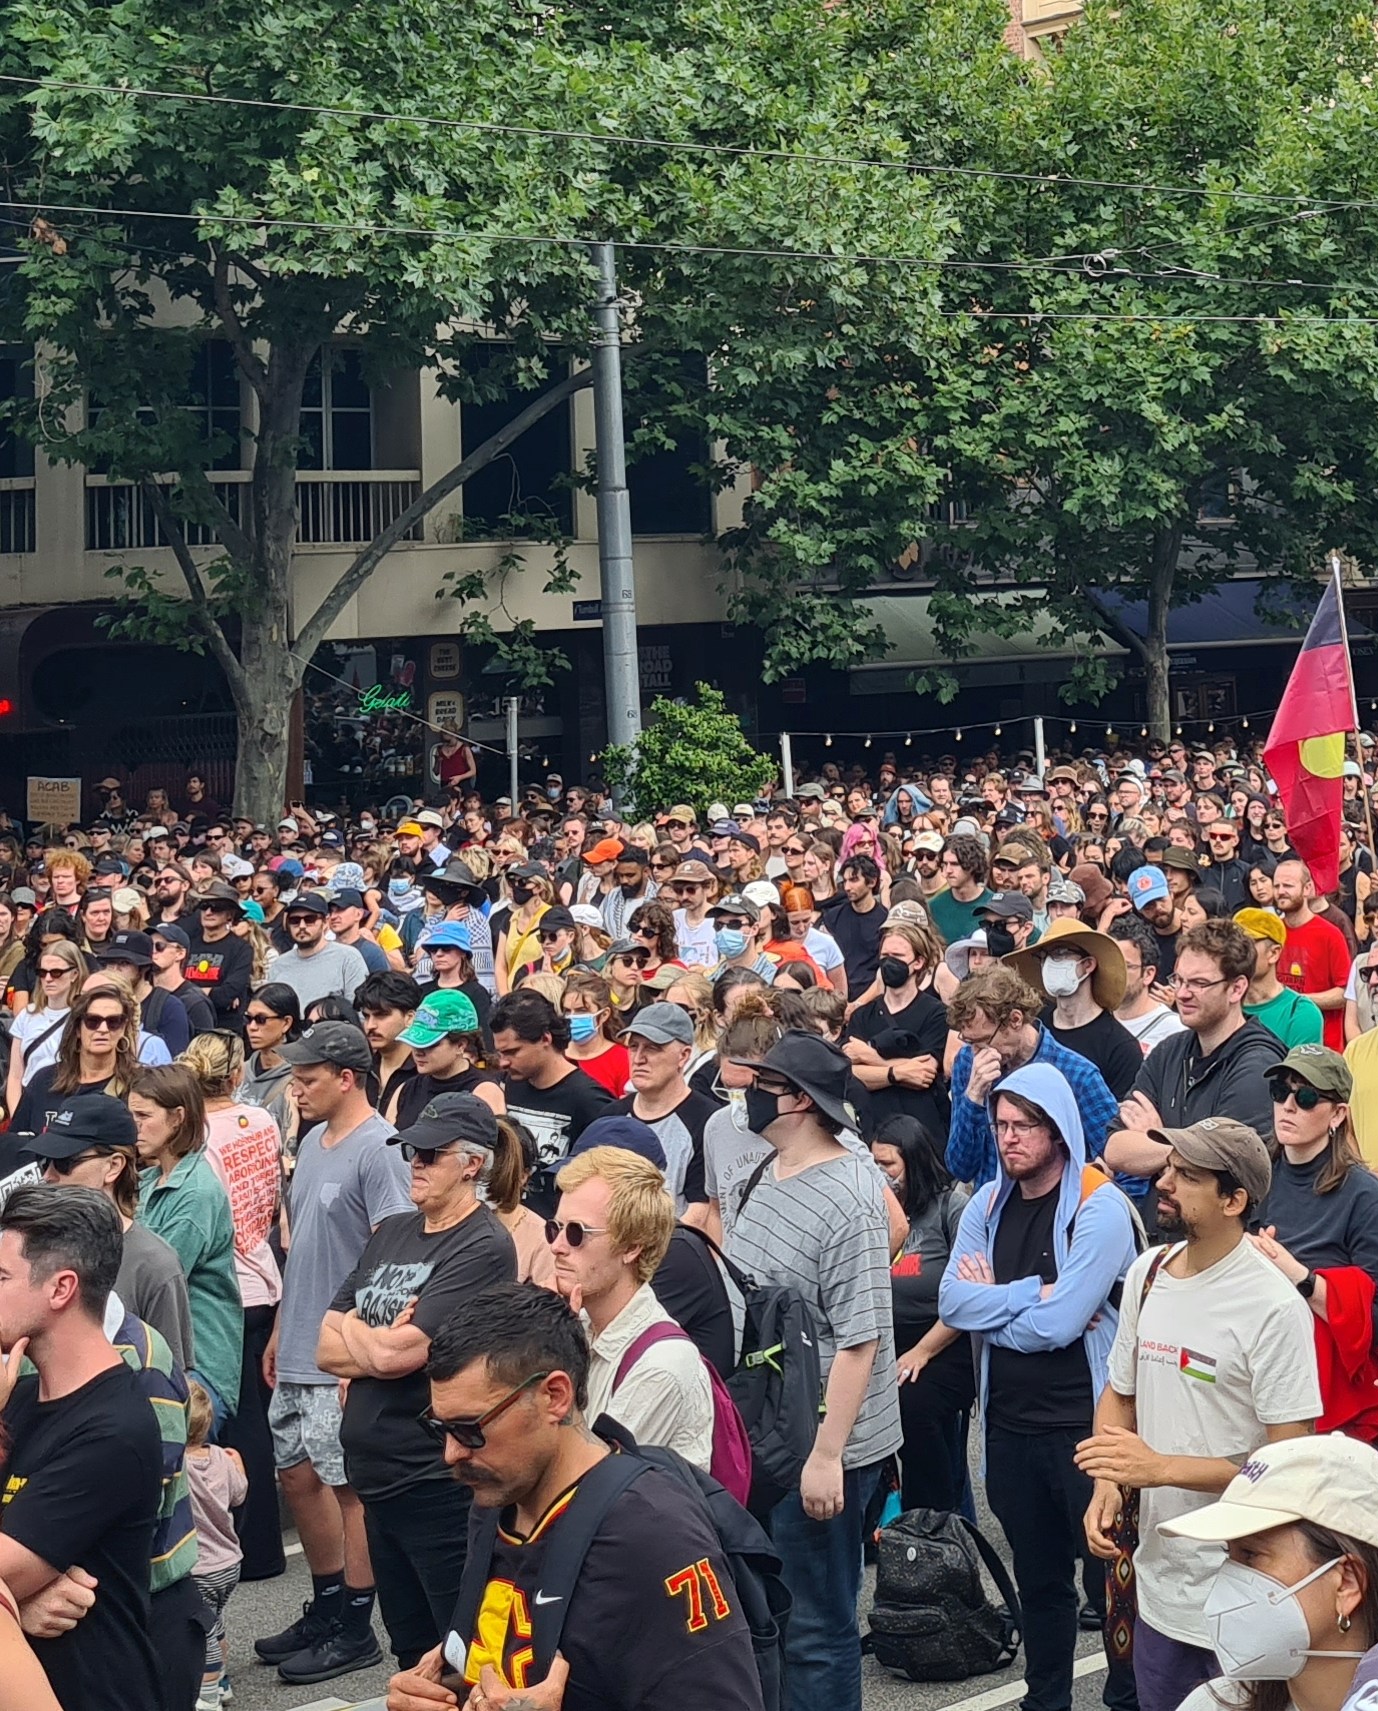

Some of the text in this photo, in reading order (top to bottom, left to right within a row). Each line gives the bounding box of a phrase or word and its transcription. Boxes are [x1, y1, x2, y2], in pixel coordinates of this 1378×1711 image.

[37, 781, 70, 792] ACAB
[223, 1135, 278, 1172] RESPECT
[664, 1557, 731, 1632] 71
